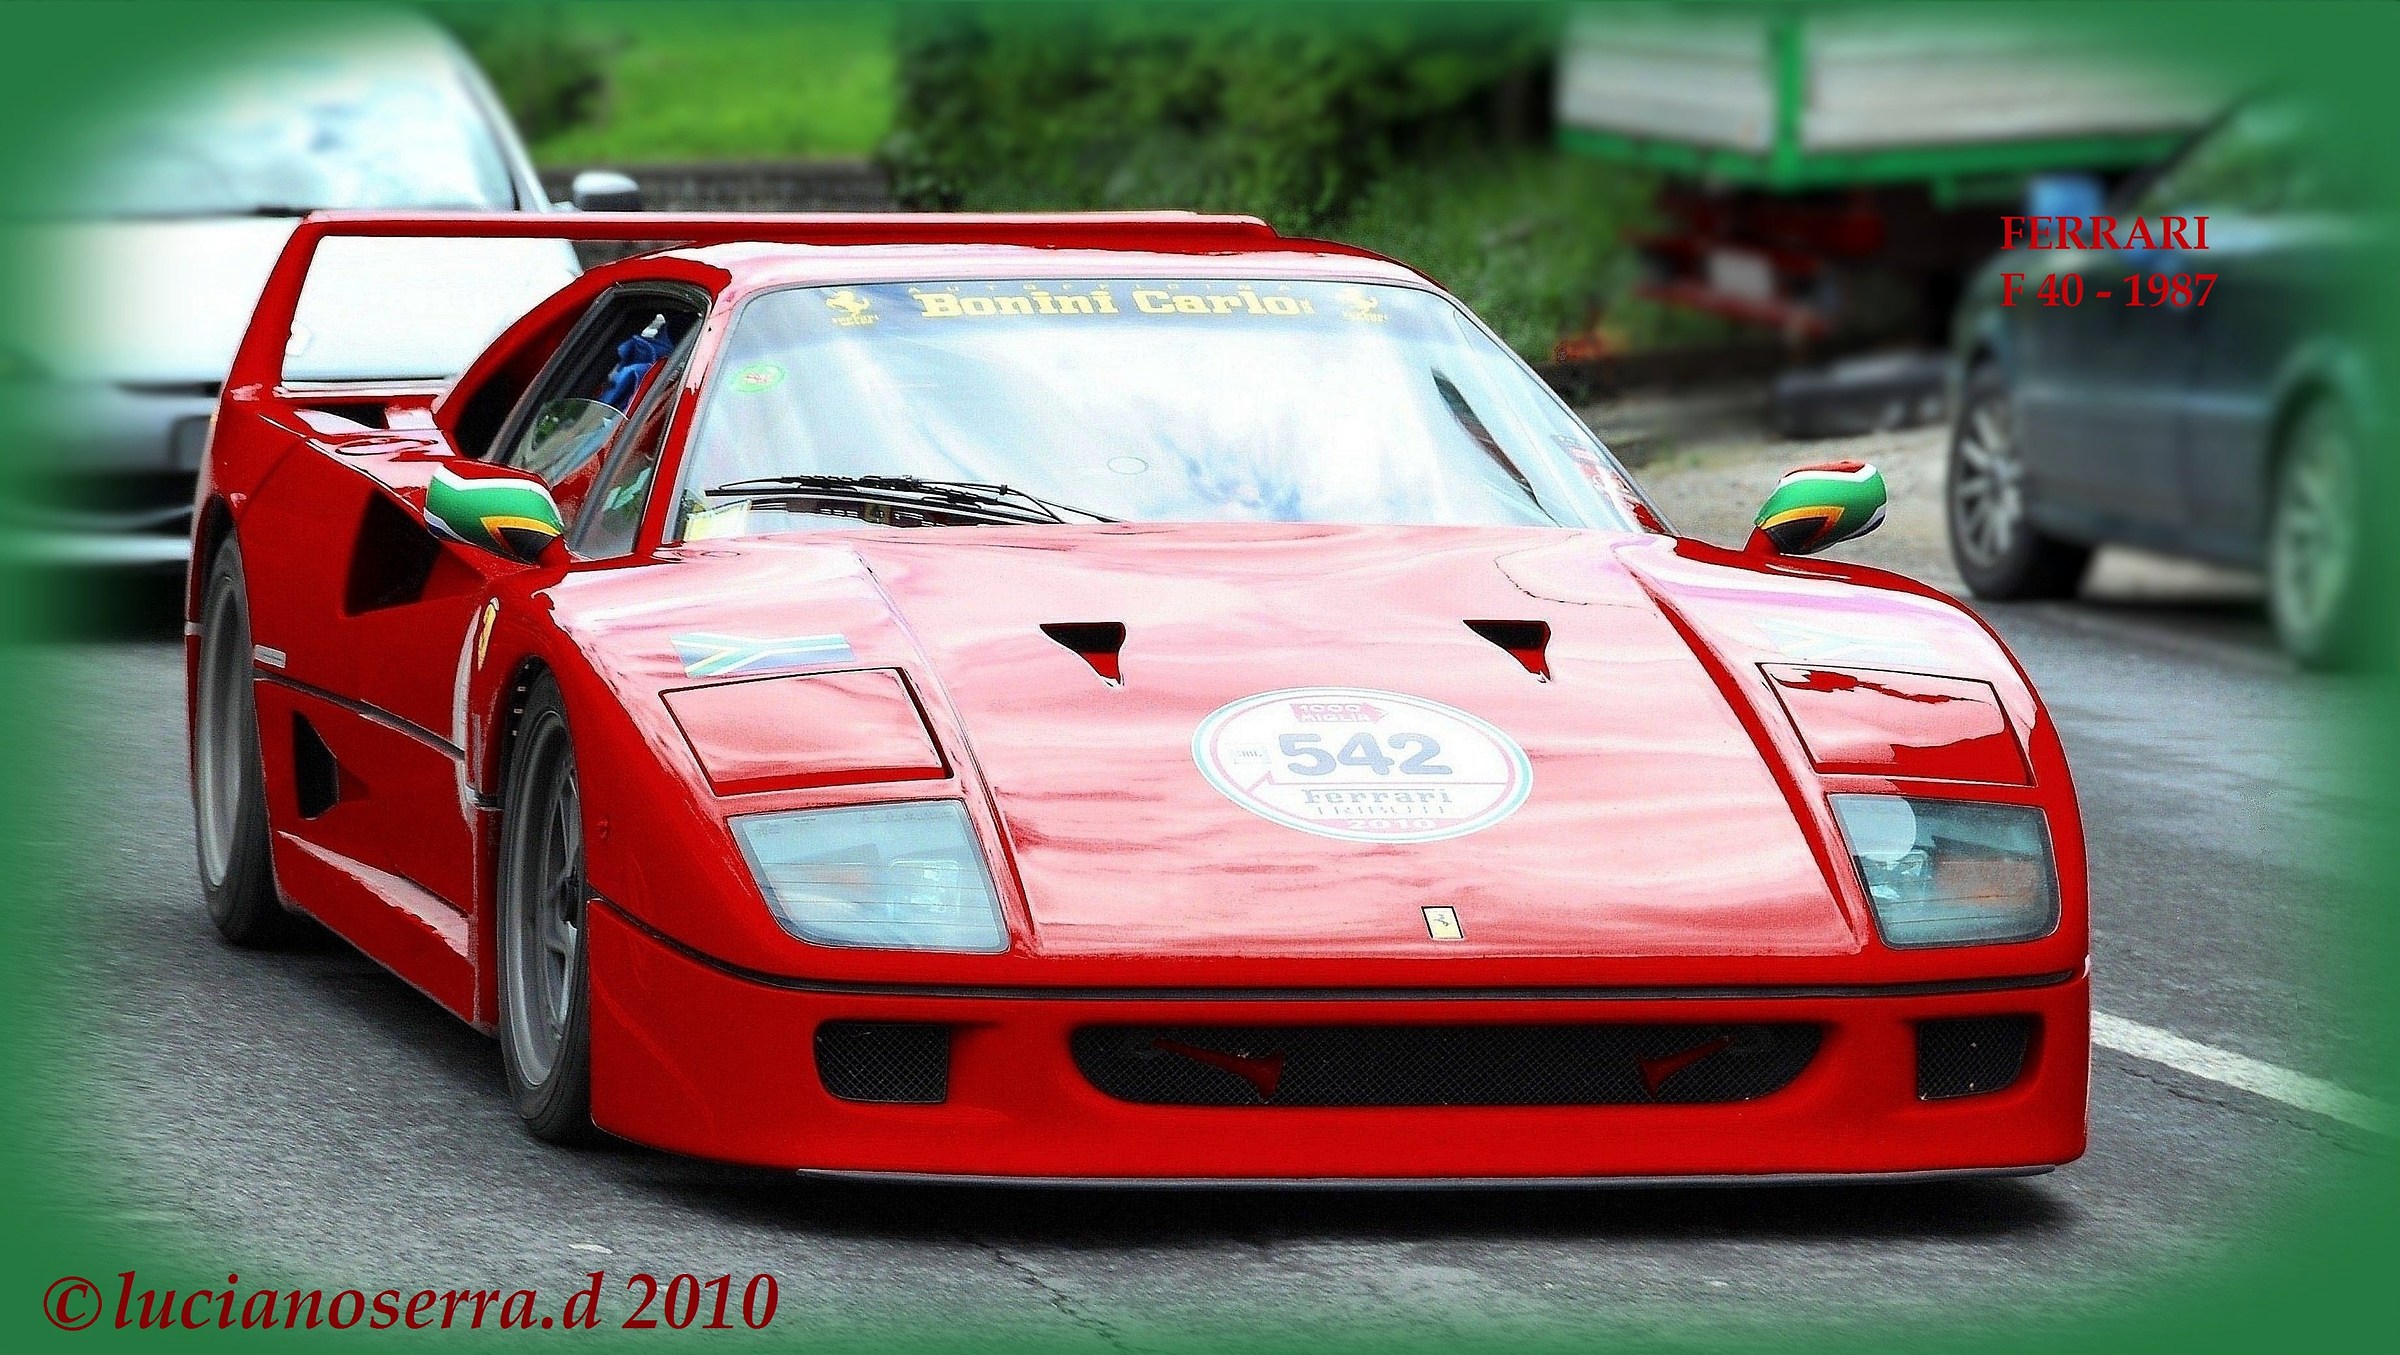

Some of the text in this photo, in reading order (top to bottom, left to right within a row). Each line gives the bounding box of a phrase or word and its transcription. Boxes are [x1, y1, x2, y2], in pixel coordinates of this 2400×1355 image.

[913, 291, 1120, 317] Bonini
[1132, 290, 1300, 315] Carlo
[1278, 732, 1453, 776] 542
[1301, 788, 1453, 804] Ferrari
[1347, 818, 1437, 831] 2010
